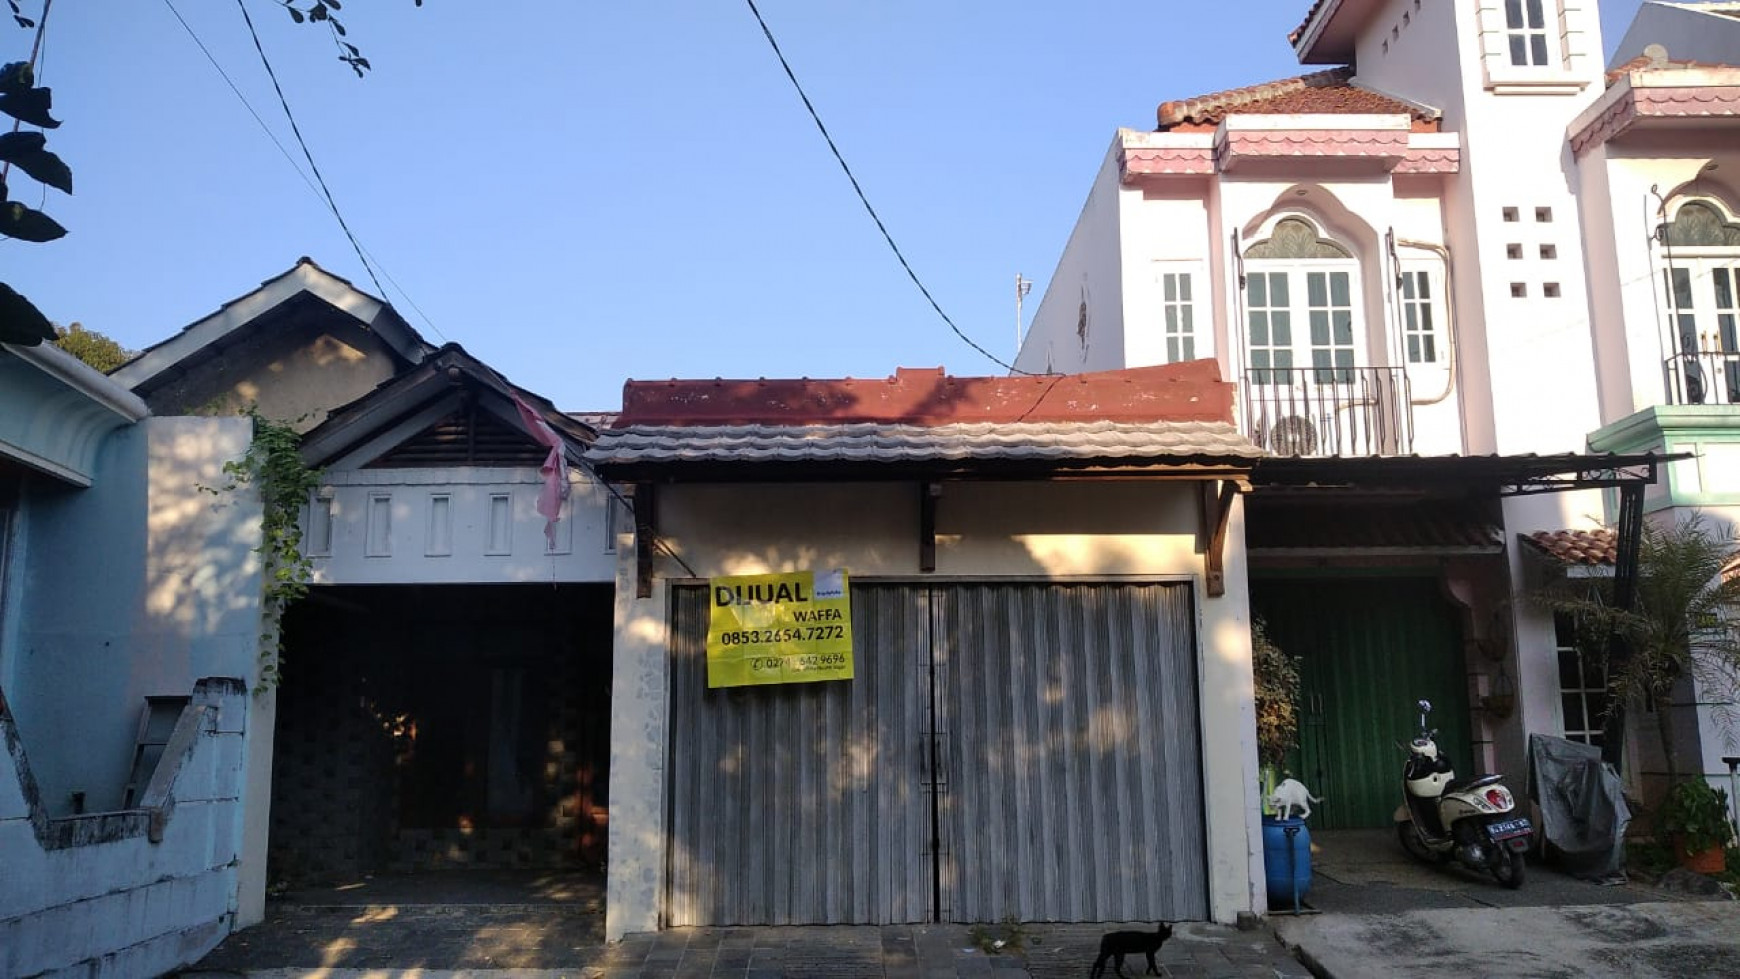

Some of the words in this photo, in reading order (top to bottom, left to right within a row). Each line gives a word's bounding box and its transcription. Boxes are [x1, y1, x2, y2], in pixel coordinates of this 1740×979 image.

[714, 582, 808, 607] DIJUAL
[793, 609, 842, 622] WAFFA
[721, 625, 844, 645] 0853.2654.7272
